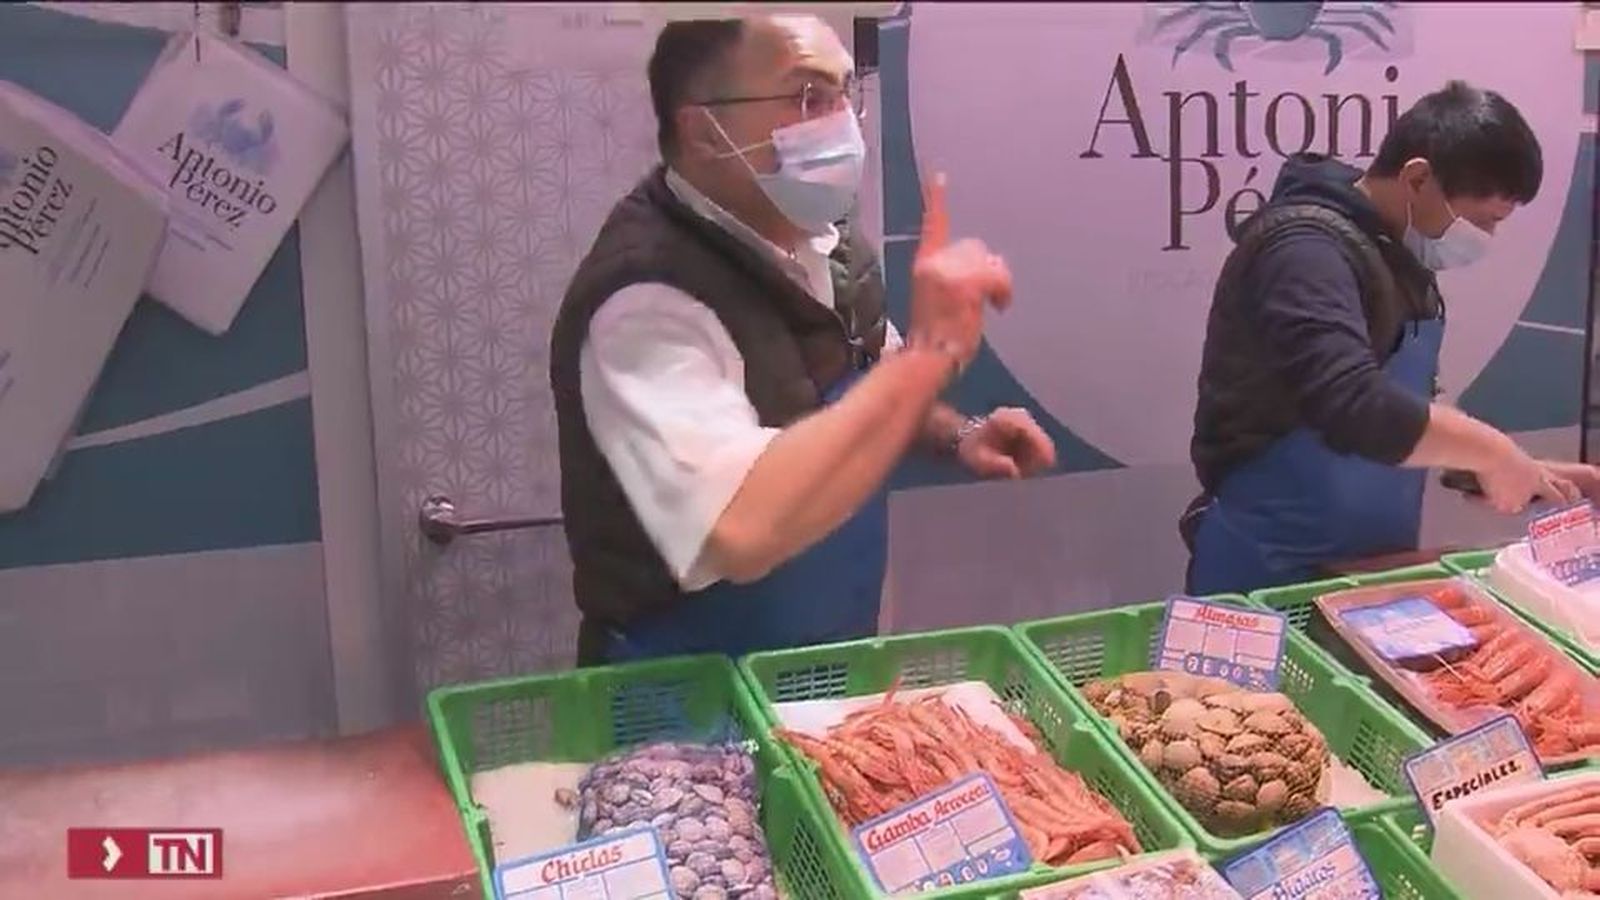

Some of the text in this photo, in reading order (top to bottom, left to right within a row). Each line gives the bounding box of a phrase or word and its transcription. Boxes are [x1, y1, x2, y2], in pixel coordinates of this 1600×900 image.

[1079, 53, 1400, 159] Antoni
[157, 132, 276, 214] Antonio
[168, 163, 247, 231] Pérez
[12, 178, 73, 254] Pérez
[867, 811, 932, 850] Gamba
